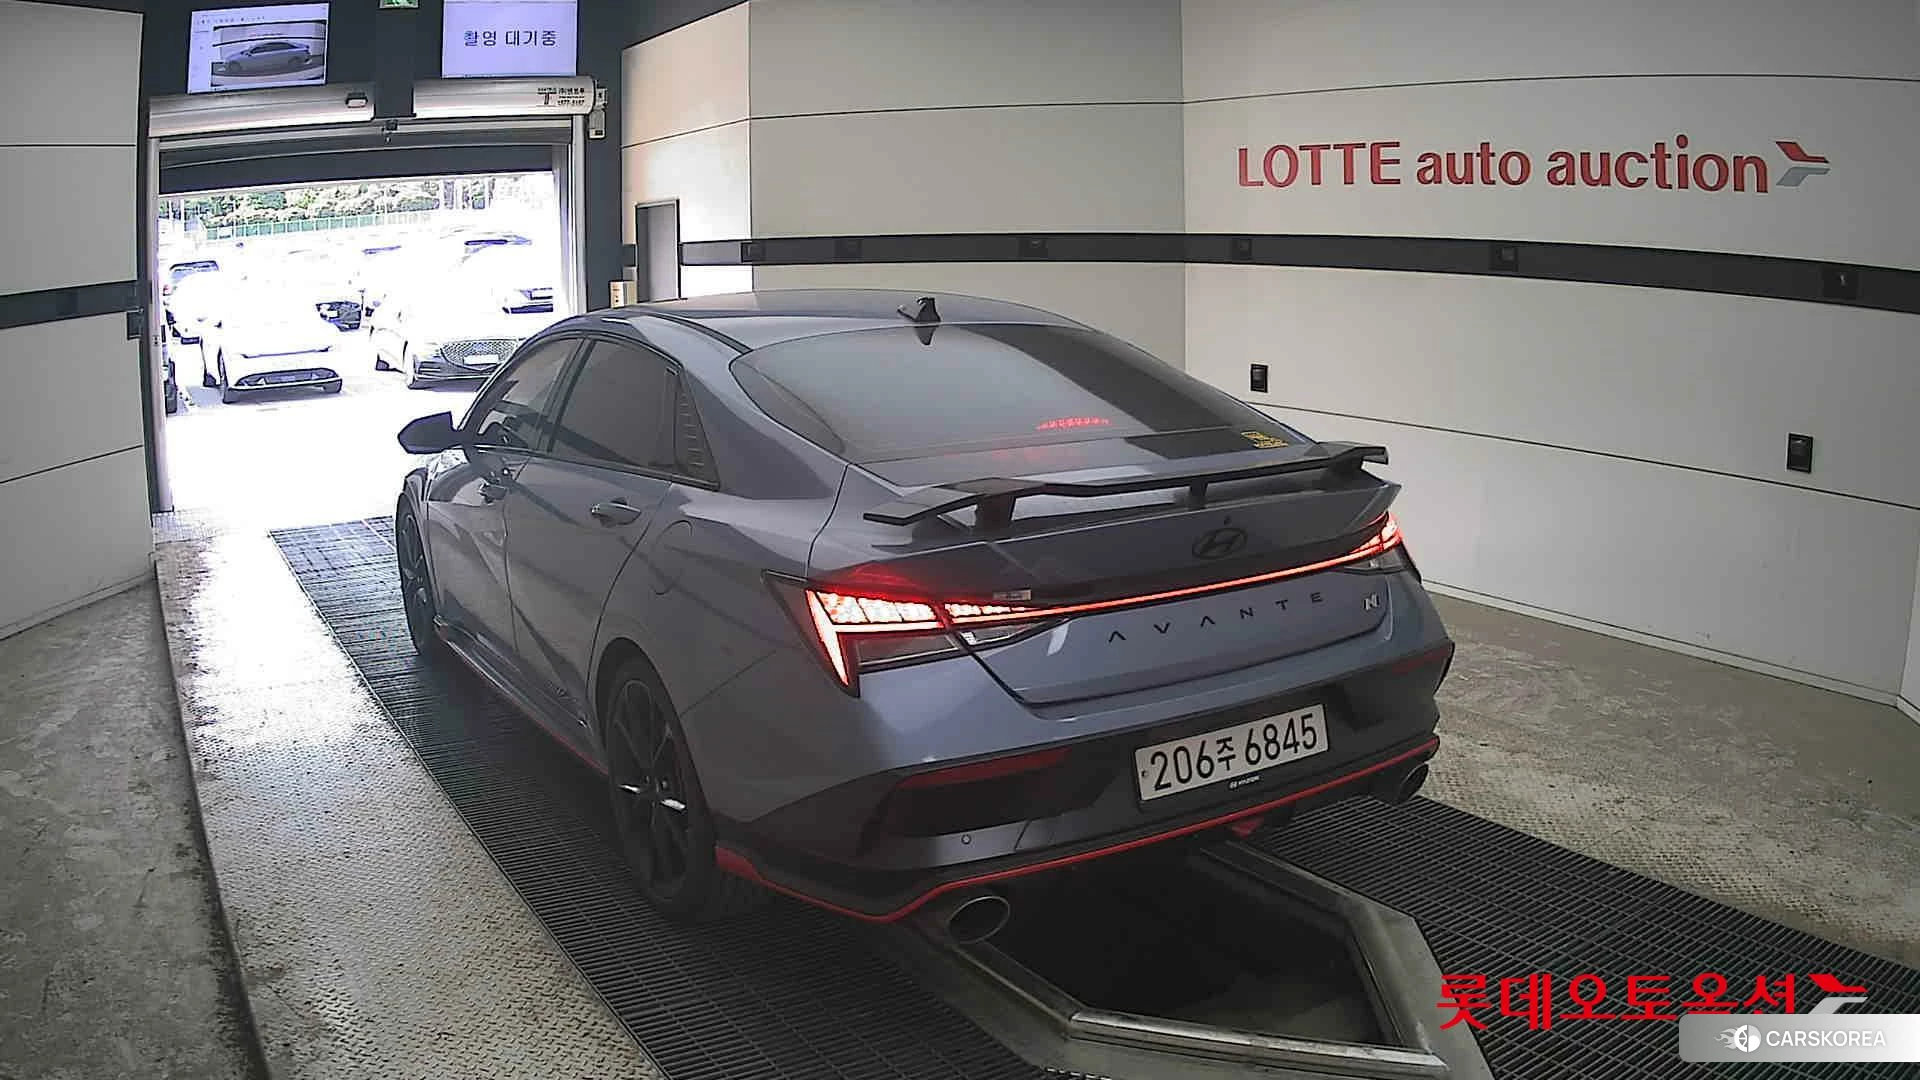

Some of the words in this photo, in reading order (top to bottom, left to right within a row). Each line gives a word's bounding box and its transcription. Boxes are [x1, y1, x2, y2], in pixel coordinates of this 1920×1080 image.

[505, 30, 558, 47] 대기중
[1238, 141, 1401, 188] LOTTE
[1416, 142, 1532, 185] auto
[1547, 134, 1769, 193] auction
[1108, 592, 1323, 642] AVANTE
[1150, 736, 1236, 791] 206주
[1245, 713, 1317, 766] 6845
